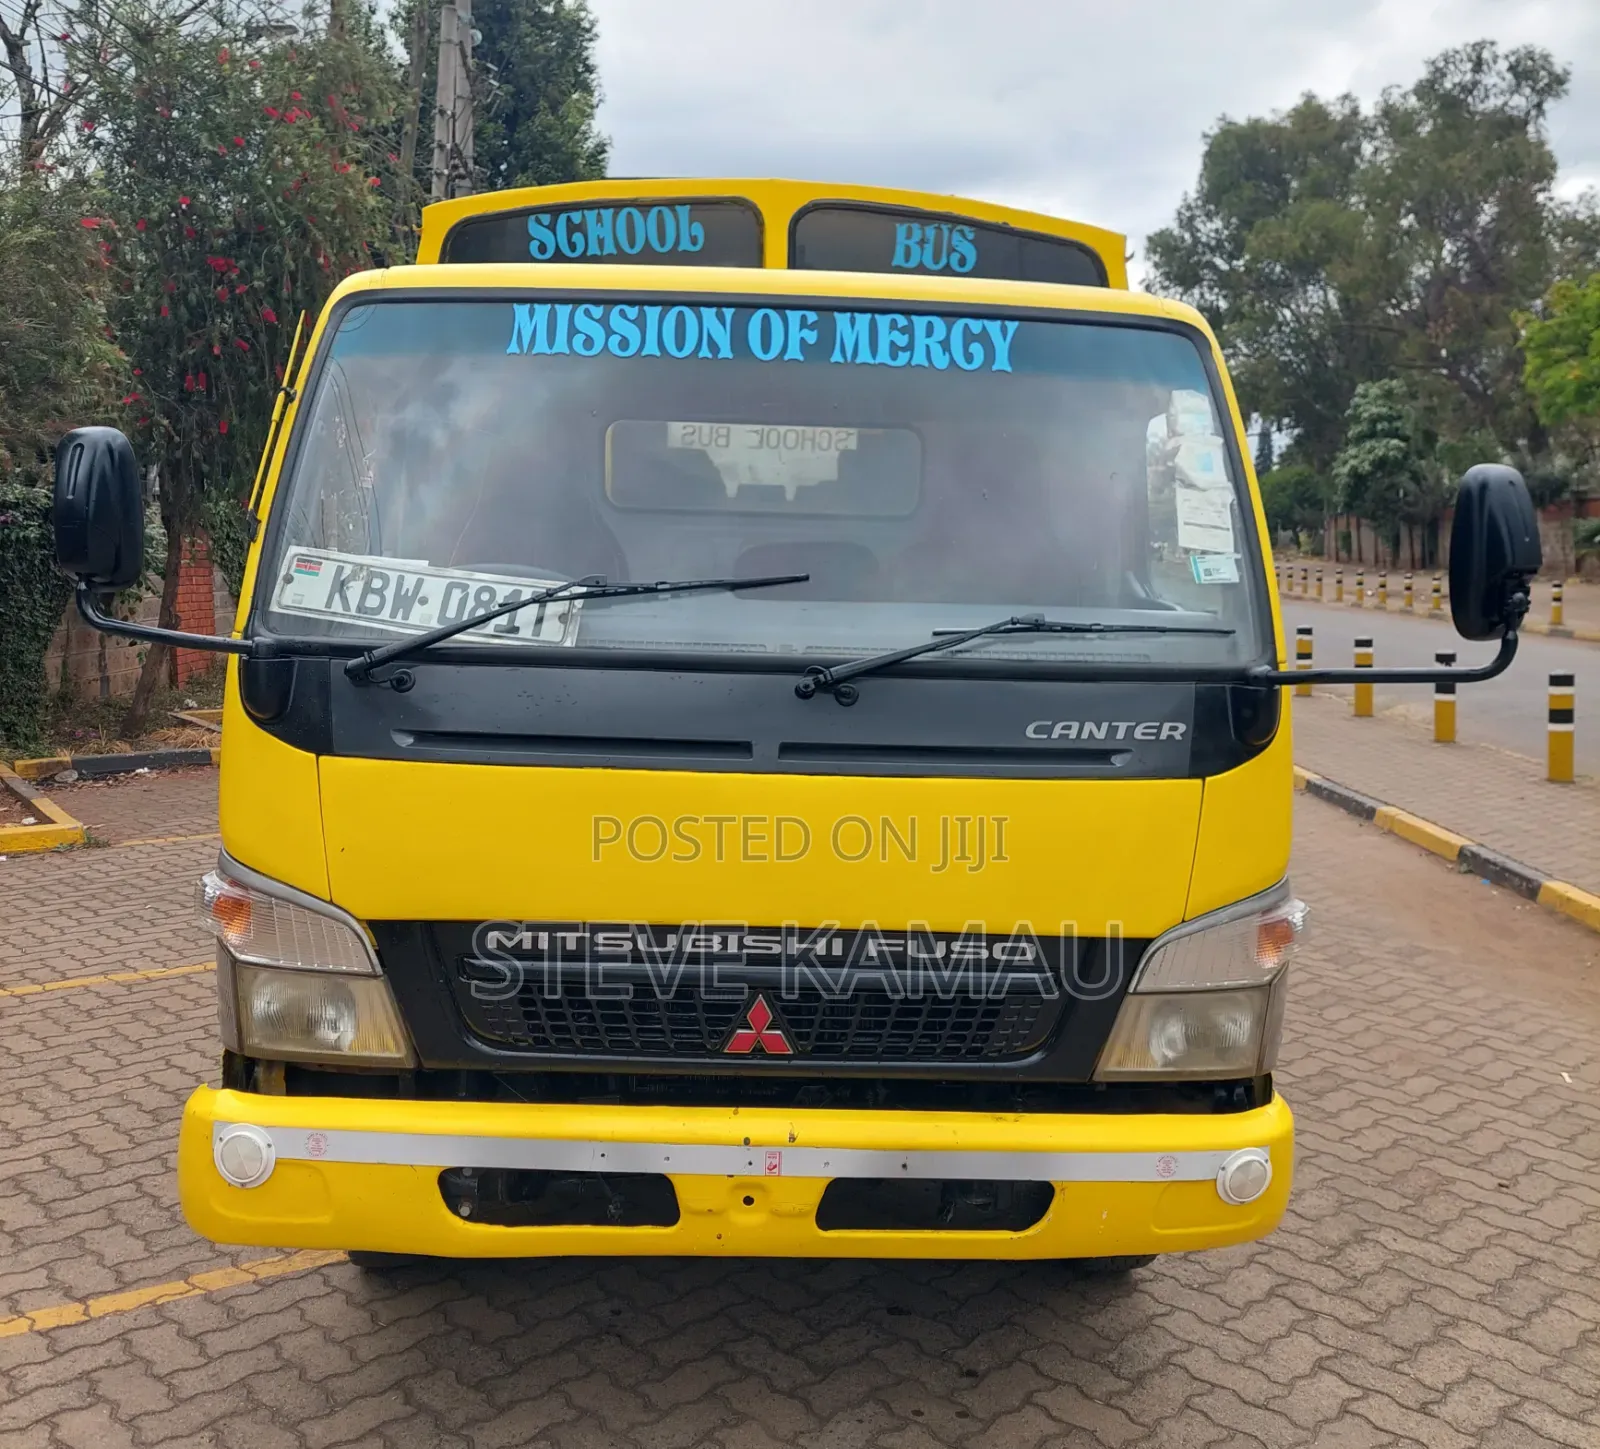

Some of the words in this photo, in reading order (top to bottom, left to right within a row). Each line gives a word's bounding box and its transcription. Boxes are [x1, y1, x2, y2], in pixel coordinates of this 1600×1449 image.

[527, 204, 705, 259] SCHOOL
[891, 222, 978, 273] BUS
[507, 303, 734, 360] MISSION
[747, 309, 818, 361] OF
[830, 312, 1019, 373] MERCY
[324, 564, 424, 621] KBW
[1025, 721, 1187, 740] CANTER
[487, 929, 843, 957] MITSUBISHI
[867, 938, 1037, 960] FUSO
